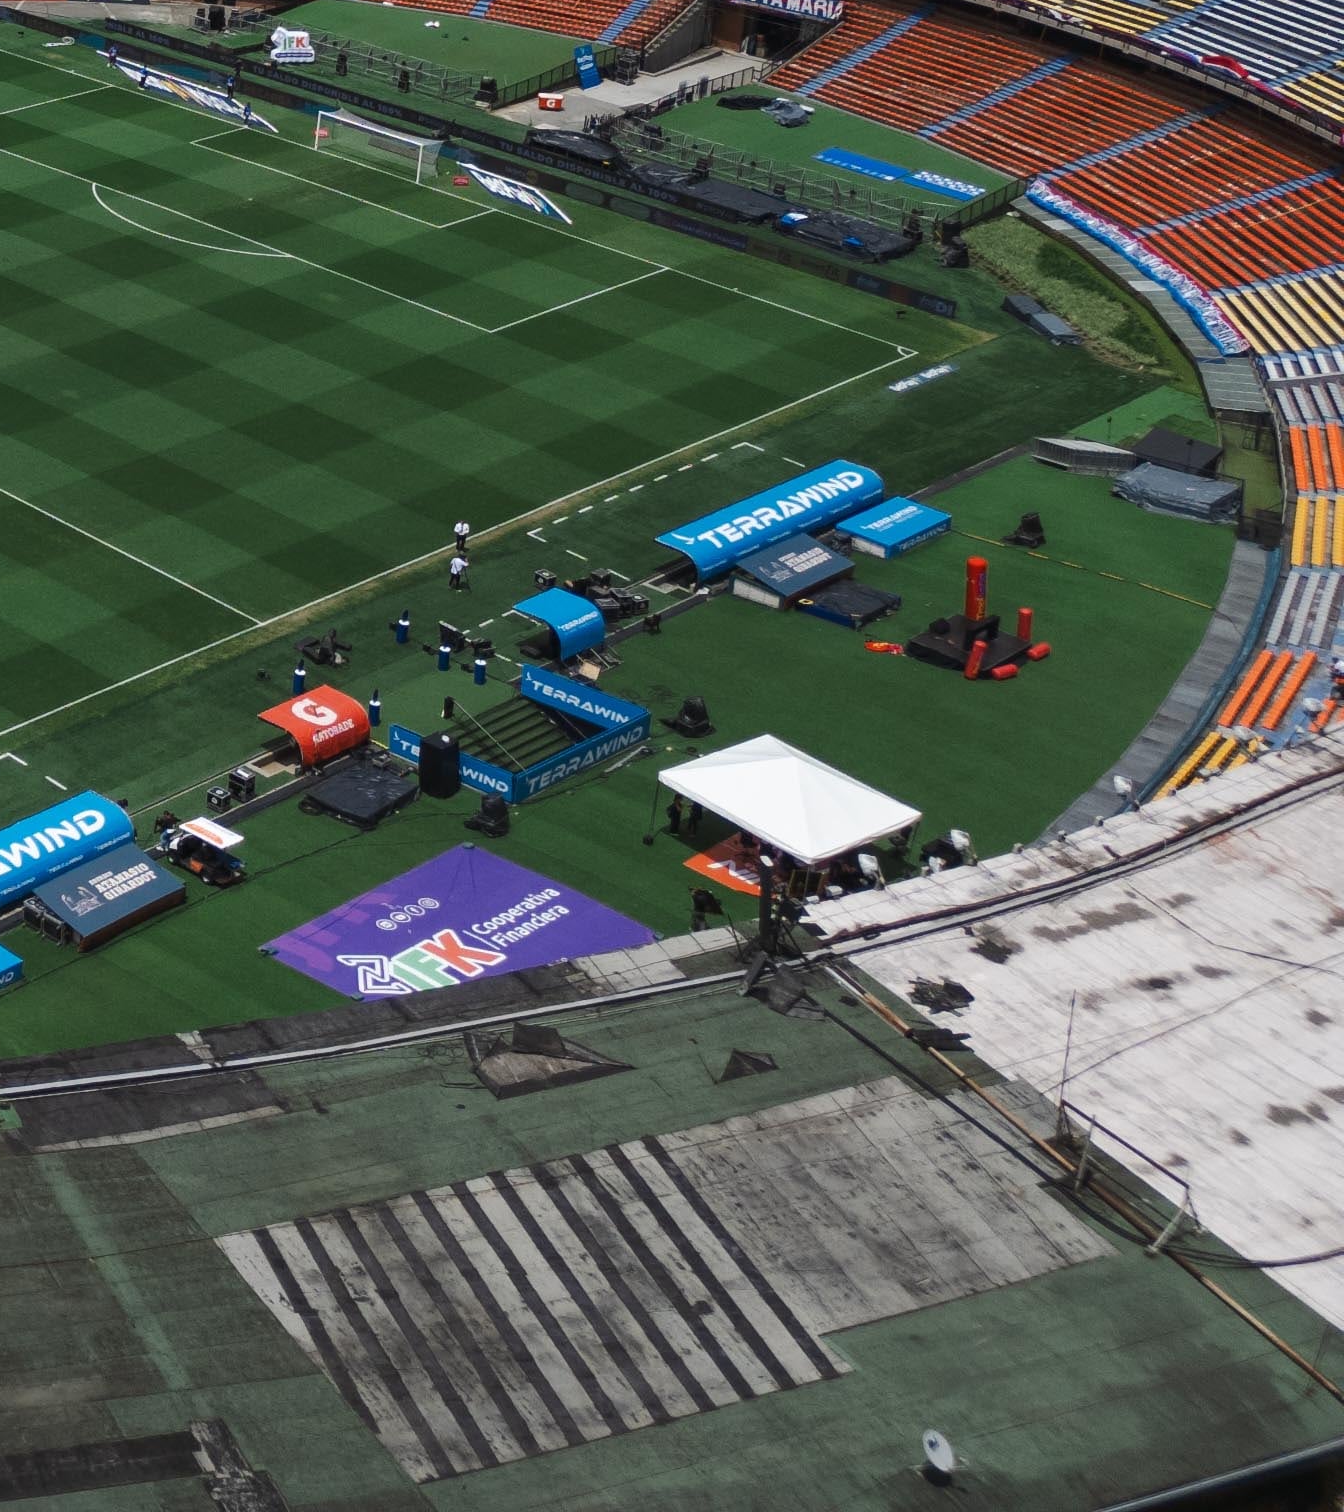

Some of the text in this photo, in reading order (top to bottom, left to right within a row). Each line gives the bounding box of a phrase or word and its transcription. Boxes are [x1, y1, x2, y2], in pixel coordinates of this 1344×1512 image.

[697, 471, 864, 549] TERRAWIND
[291, 698, 338, 726] G
[530, 678, 630, 725] TERRAWIN
[399, 739, 510, 793] TEWIND
[528, 725, 644, 795] TERRAWIND
[96, 862, 151, 894] ATANASIO
[103, 870, 158, 901] GIRARDOT
[471, 887, 561, 936] Cooperativa
[491, 904, 570, 948] Financiera
